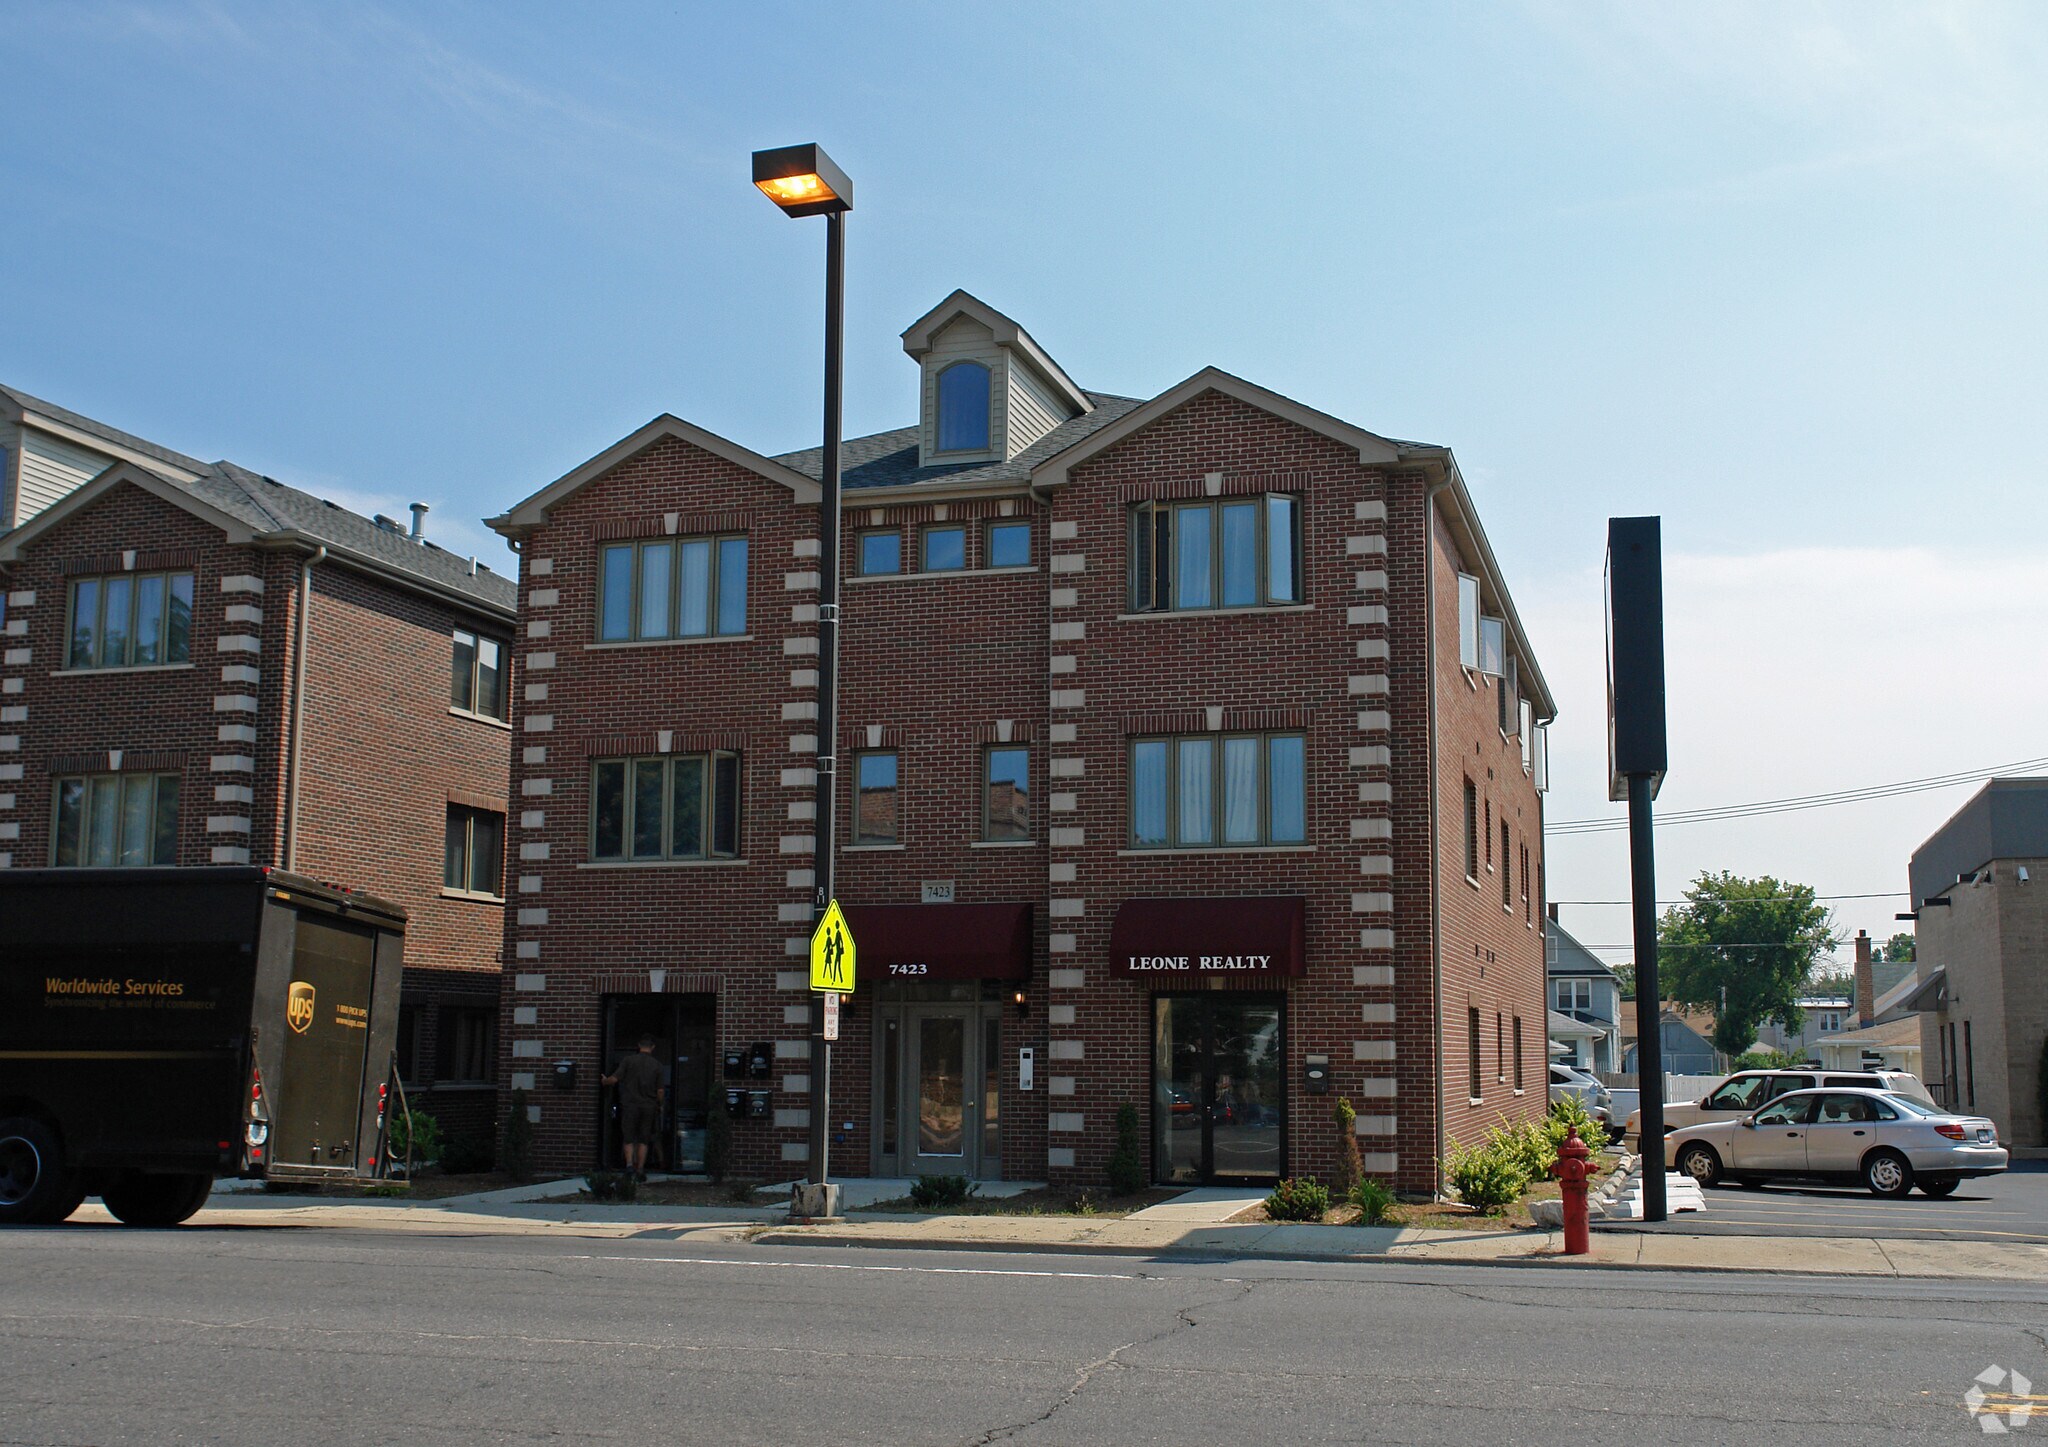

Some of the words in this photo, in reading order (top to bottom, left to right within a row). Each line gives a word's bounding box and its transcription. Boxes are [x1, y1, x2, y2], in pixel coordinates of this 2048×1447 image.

[927, 886, 951, 898] 7423
[1129, 956, 1190, 970] LEONE
[1199, 955, 1271, 969] REALTY
[889, 964, 928, 975] 7423
[46, 978, 121, 994] Worldwide
[124, 978, 184, 995] Services
[109, 997, 125, 1008] the
